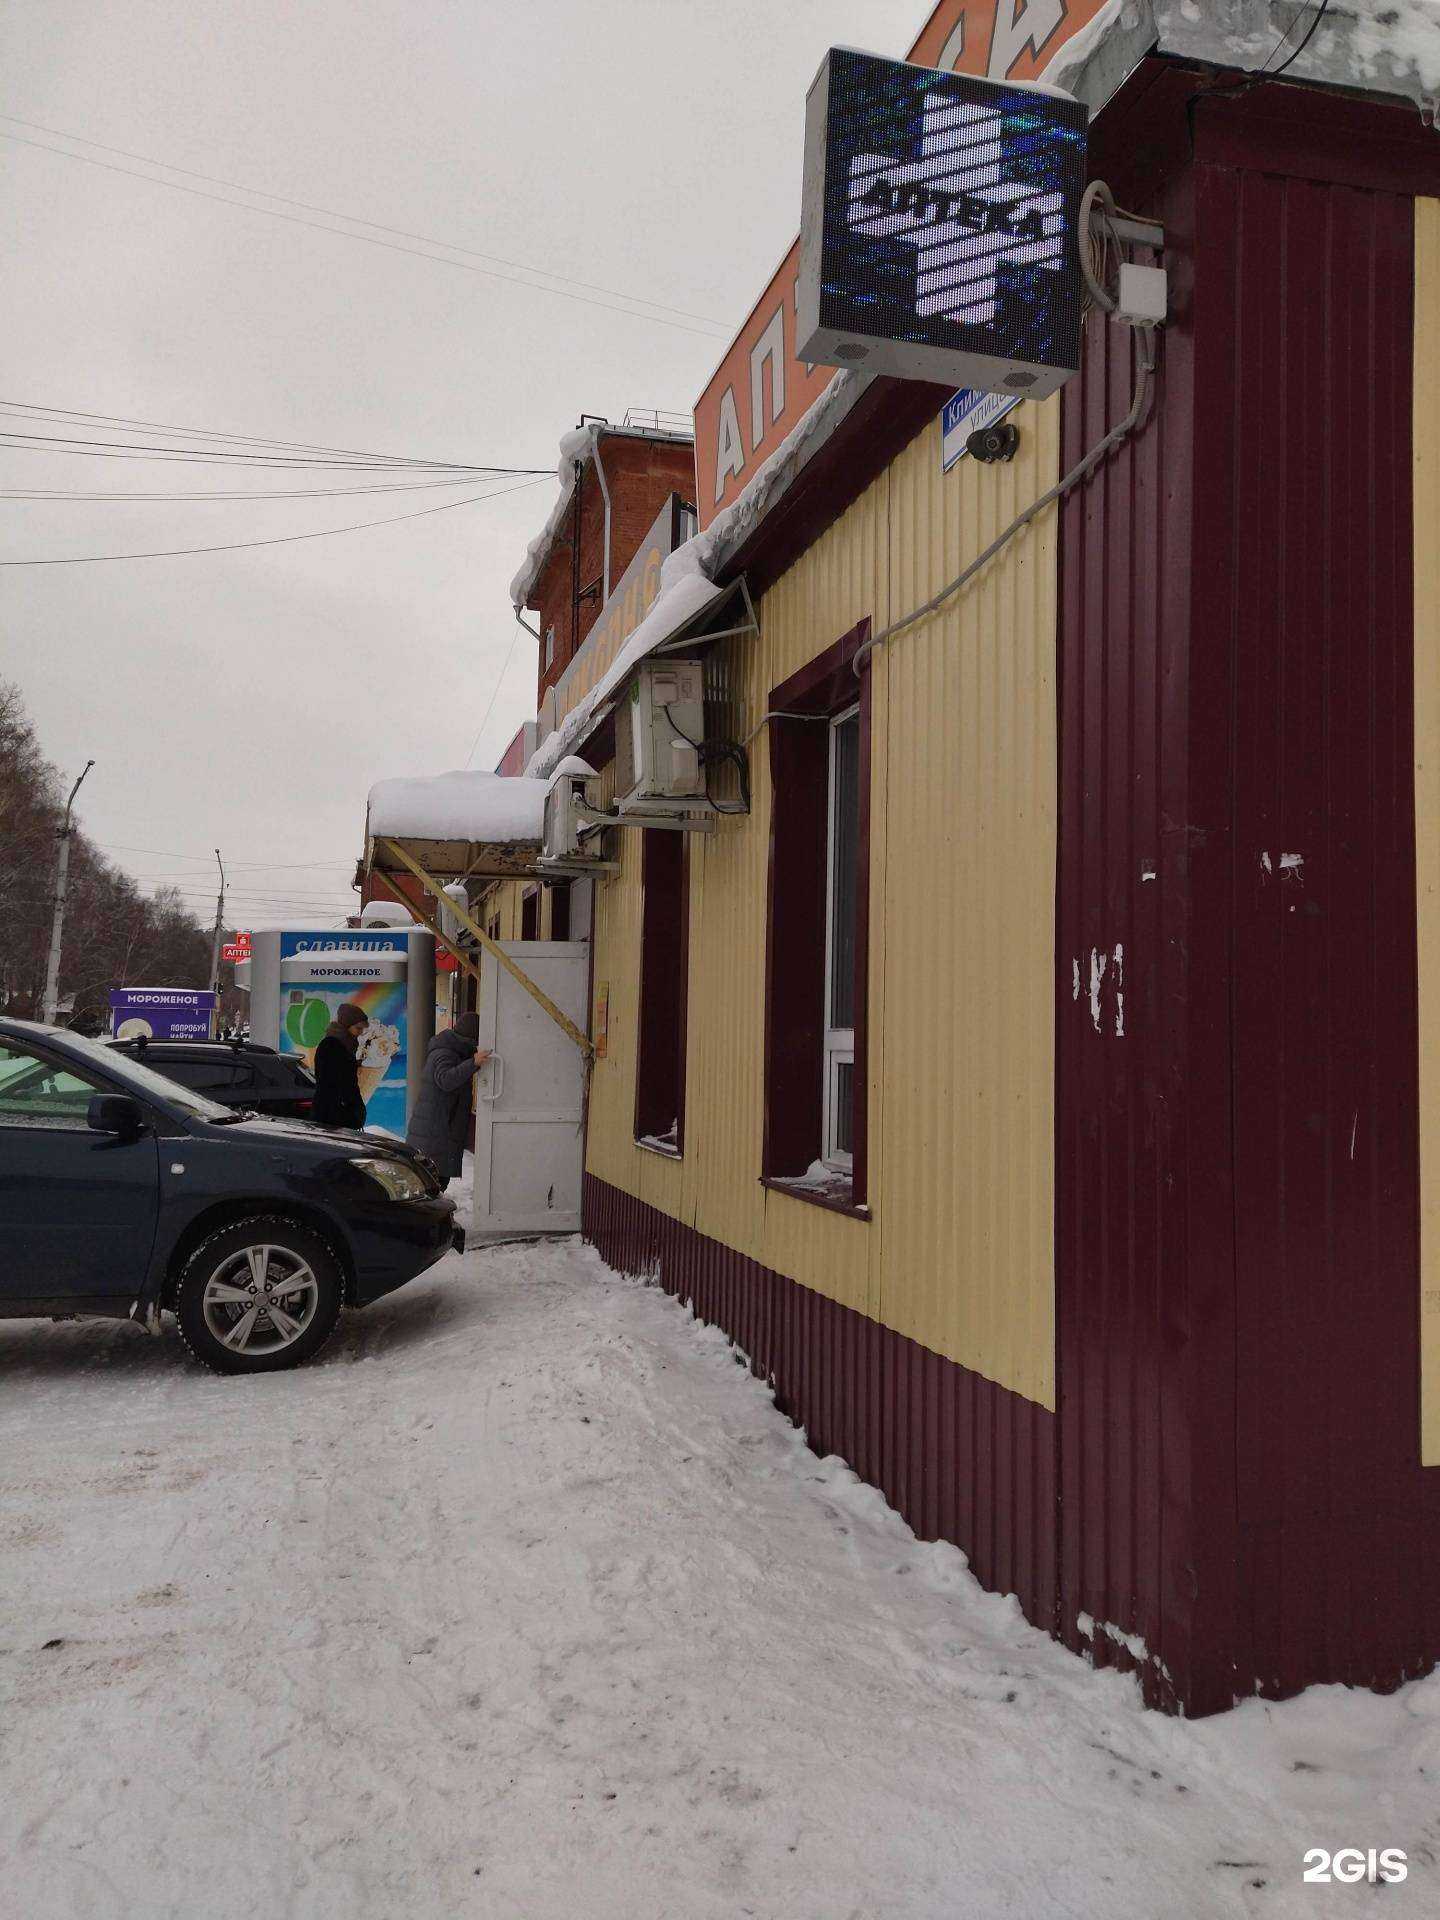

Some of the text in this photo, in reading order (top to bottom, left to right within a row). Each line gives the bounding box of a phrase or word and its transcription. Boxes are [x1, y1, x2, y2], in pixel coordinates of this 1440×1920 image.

[867, 177, 1043, 237] АПТЕКА
[948, 389, 983, 428] Клим
[310, 968, 381, 976] МОРОЖЕНОЕ
[127, 994, 199, 1004] МОРОЖЕНОЕ
[170, 1023, 207, 1032] ПОПРОБУЙ
